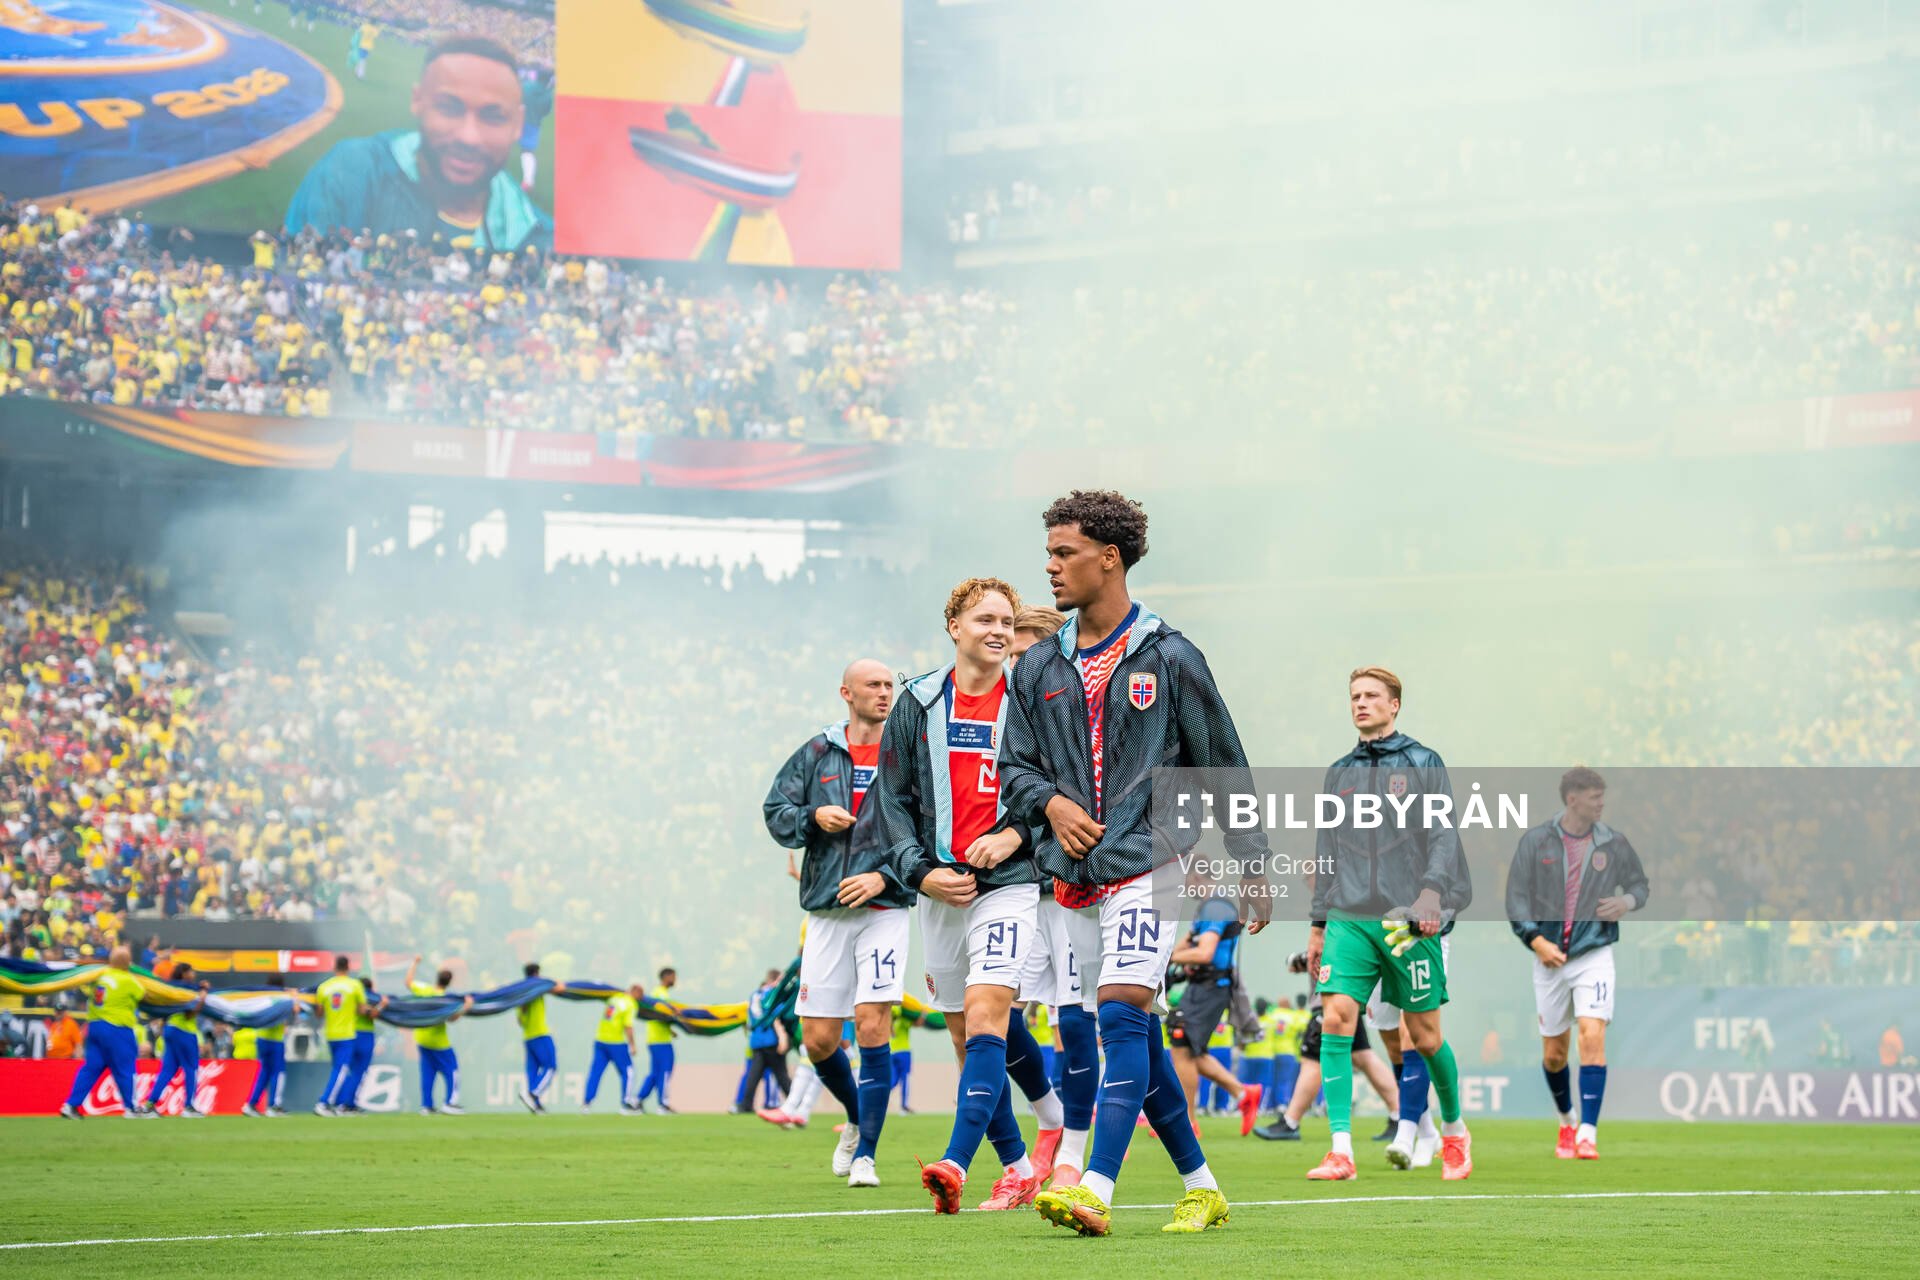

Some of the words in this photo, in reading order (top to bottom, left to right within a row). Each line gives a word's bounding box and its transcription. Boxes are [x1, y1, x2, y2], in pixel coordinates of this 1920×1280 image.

[985, 921, 1018, 959] 21
[1117, 908, 1160, 953] 22
[871, 948, 896, 979] 14
[1406, 959, 1432, 990] 12
[1593, 981, 1608, 1002] 11
[1660, 1071, 1818, 1122] QATAR
[1837, 1072, 1920, 1118] AIR
